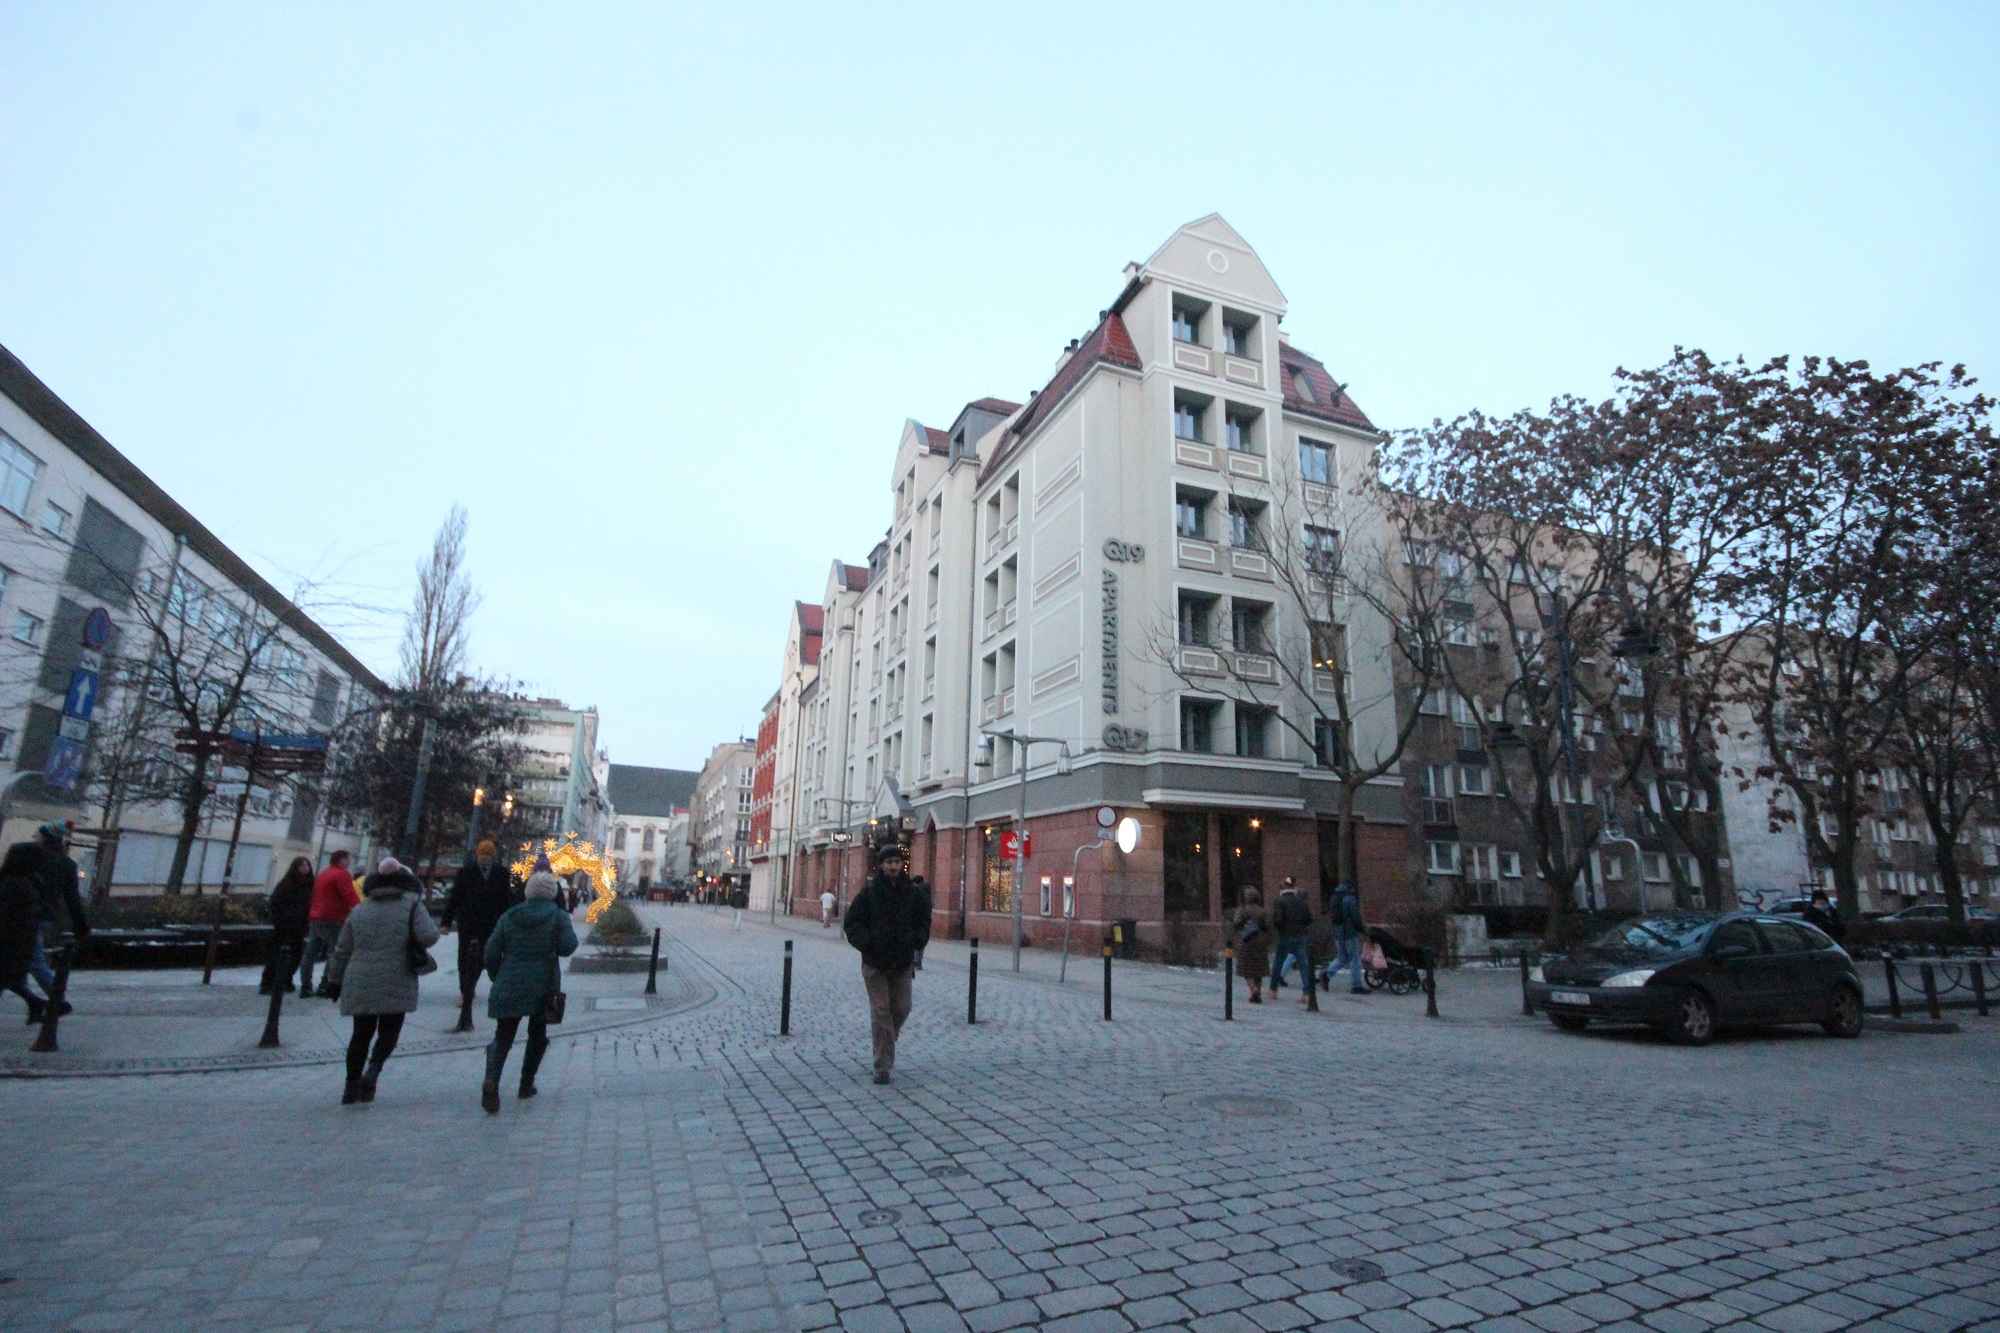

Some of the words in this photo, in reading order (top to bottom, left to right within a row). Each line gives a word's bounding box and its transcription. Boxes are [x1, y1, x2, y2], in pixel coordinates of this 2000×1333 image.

[1102, 537, 1146, 563] Q19
[1102, 567, 1119, 715] APARTMENTS
[1102, 722, 1149, 752] Q17
